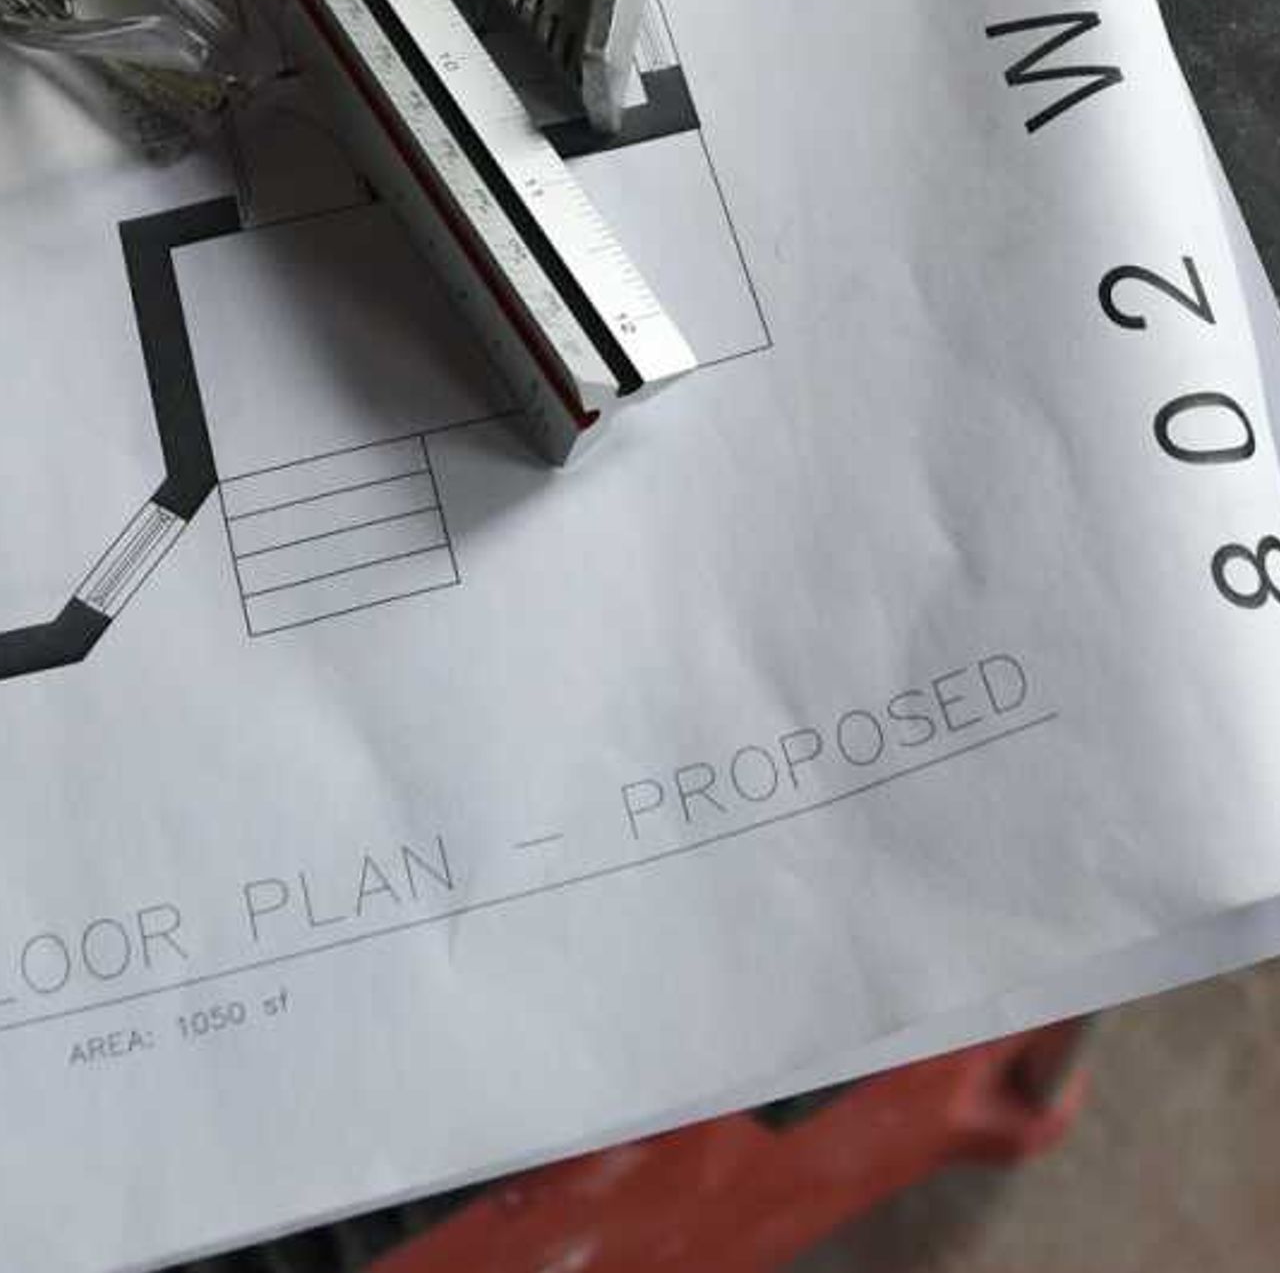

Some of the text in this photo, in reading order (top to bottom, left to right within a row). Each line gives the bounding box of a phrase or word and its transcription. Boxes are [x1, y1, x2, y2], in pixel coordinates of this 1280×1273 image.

[614, 312, 637, 337] 12
[242, 832, 457, 941] PLAN
[620, 651, 1029, 841] PROPOSED
[68, 1029, 156, 1066] AREA:
[176, 1000, 248, 1038] 1050
